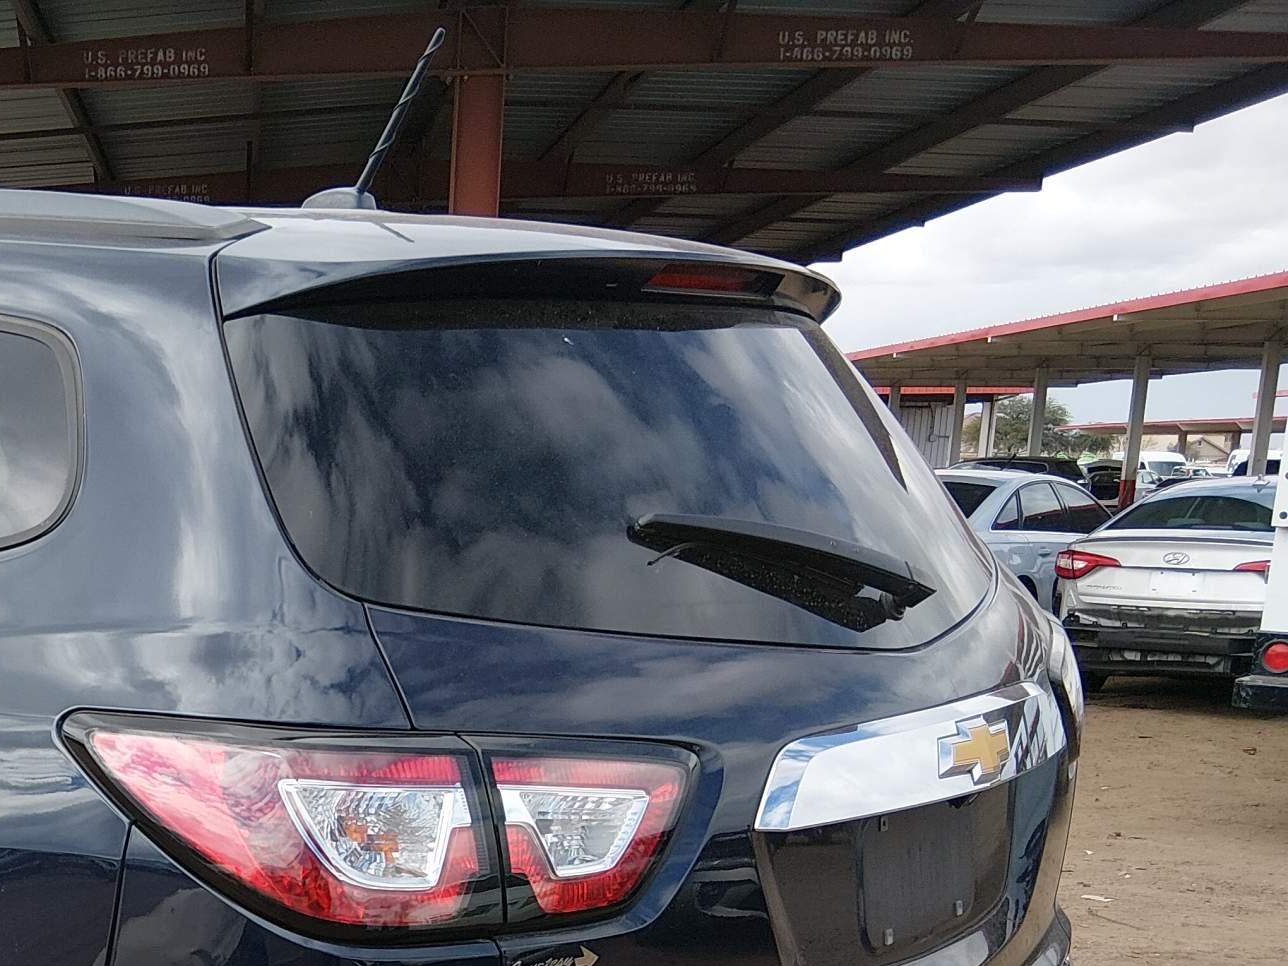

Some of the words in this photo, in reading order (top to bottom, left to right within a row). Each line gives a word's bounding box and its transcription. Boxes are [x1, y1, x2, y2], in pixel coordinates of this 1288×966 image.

[778, 30, 808, 45] U.S.
[816, 29, 877, 45] PREFAB
[885, 28, 915, 44] INC.
[83, 50, 112, 65] U.S.
[118, 48, 176, 64] PREFAB
